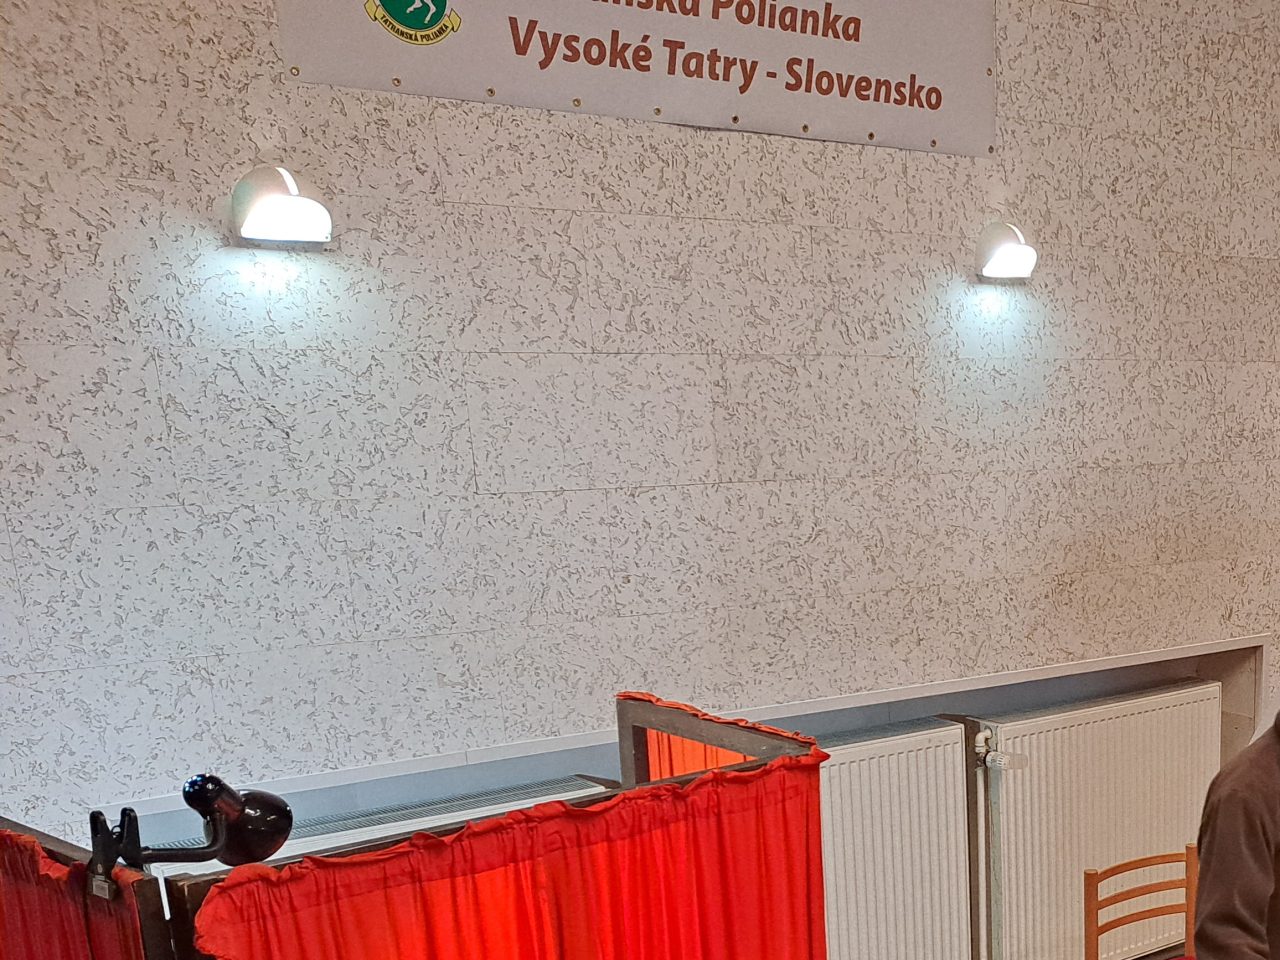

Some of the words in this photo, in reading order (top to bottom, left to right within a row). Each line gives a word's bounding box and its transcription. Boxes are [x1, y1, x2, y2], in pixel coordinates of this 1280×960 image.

[420, 23, 449, 42] POLIANKA
[711, 0, 861, 42] Polianka
[508, 16, 651, 72] Vysoké
[662, 38, 758, 95] Tatry
[784, 57, 943, 111] Slovensko
